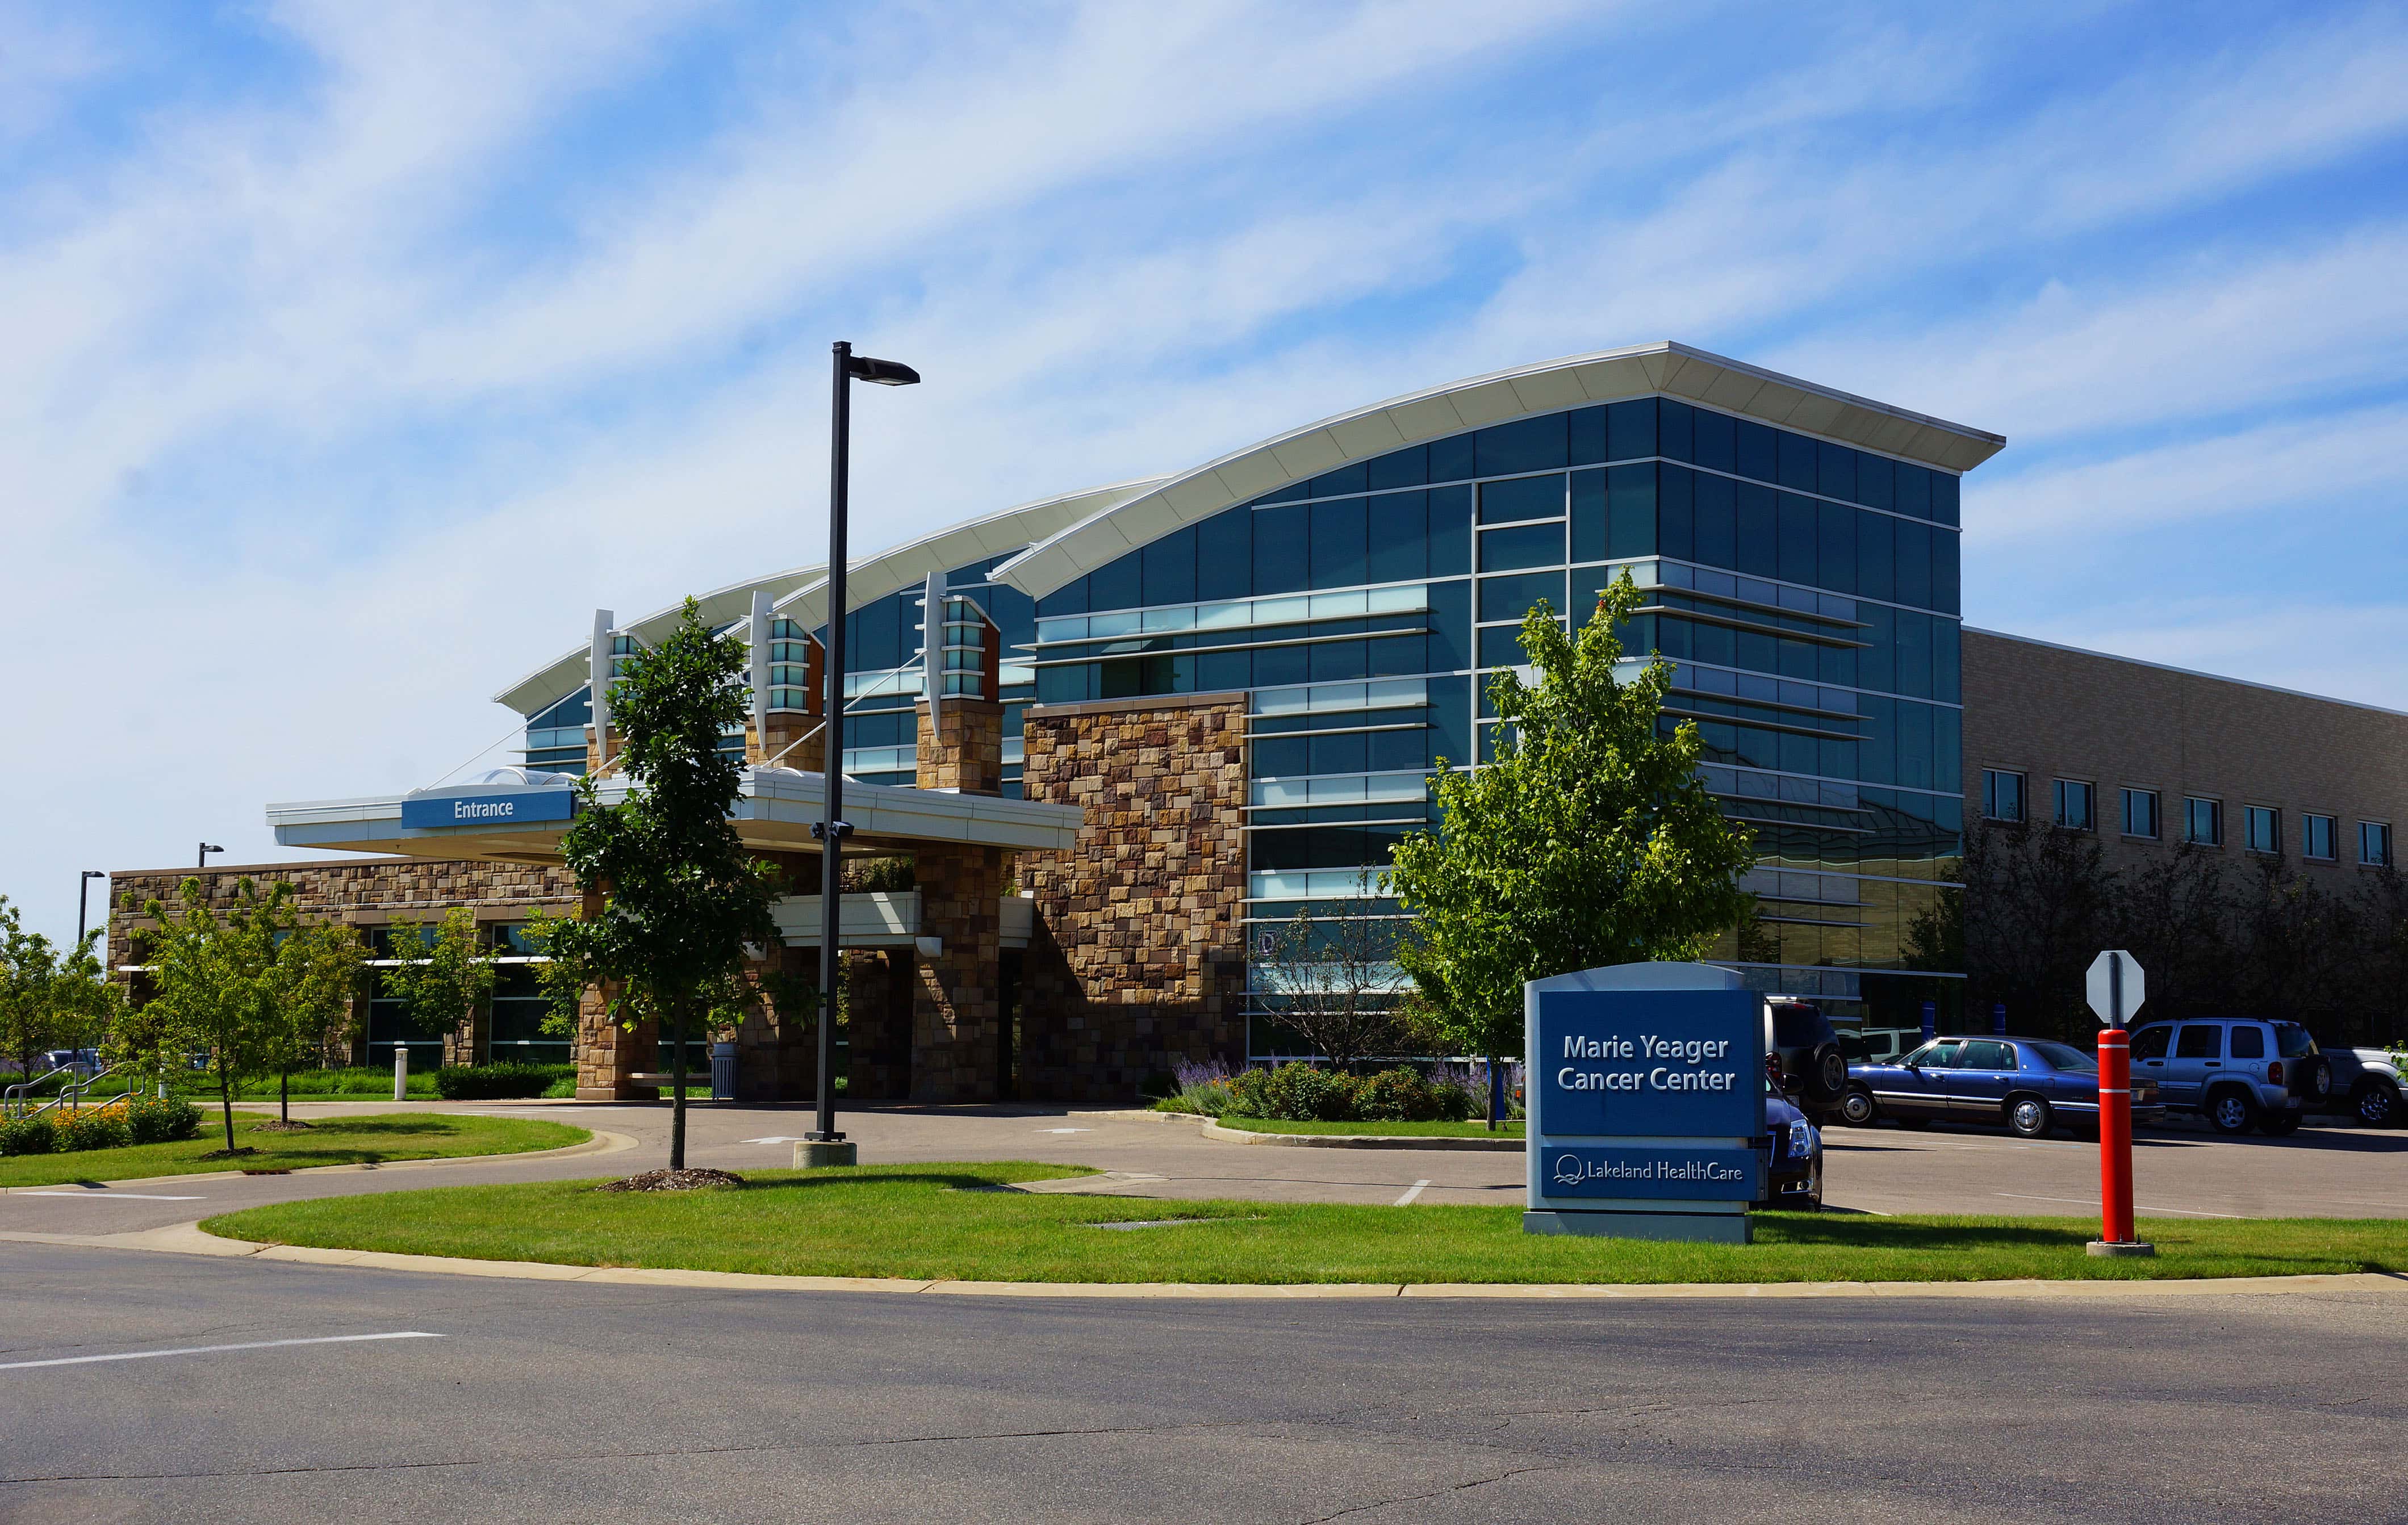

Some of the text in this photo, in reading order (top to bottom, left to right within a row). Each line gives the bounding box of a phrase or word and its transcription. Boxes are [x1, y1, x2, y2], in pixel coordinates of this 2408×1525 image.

[455, 801, 513, 818] Entrance
[1564, 1035, 1729, 1064] Marie Yeager
[1558, 1067, 1736, 1090] Cancer Center
[1588, 1160, 1744, 1180] Lakeland HealthCare
